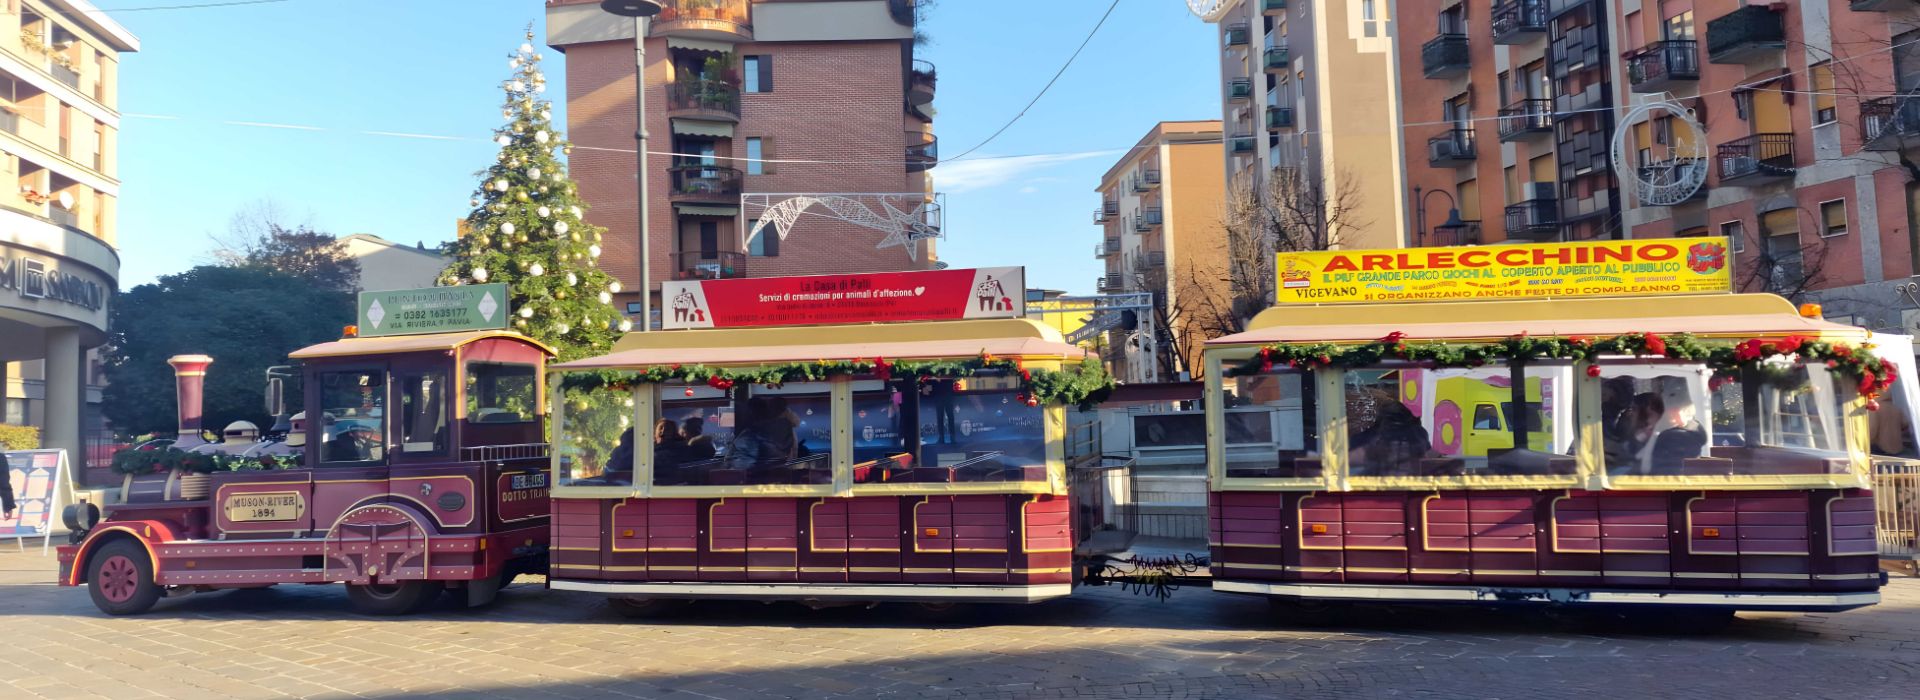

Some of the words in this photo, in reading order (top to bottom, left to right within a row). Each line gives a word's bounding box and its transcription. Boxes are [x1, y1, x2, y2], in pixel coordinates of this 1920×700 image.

[1322, 244, 1680, 272] ARLECCHINO
[1323, 273, 1333, 283] IL
[1357, 271, 1401, 282] GRANDE
[1403, 270, 1440, 281] PARCO
[1442, 268, 1480, 279] GIOCHI
[1482, 268, 1496, 279] AL
[1502, 266, 1553, 278] COPERTO
[1557, 264, 1600, 276] APERTO
[1604, 263, 1620, 275] AL
[1622, 262, 1681, 274] PUBBLICO
[800, 280, 811, 292] La
[814, 280, 837, 291] Casa
[839, 279, 848, 290] di
[759, 292, 782, 302] Servizi
[784, 292, 791, 301] di
[846, 289, 872, 300] animali
[1296, 286, 1357, 299] VIGEVANO
[1364, 293, 1373, 301] SI
[1378, 291, 1472, 300] ORGANIZZANO
[1476, 289, 1521, 297] ANCHE
[1525, 288, 1561, 296] FESTE
[1583, 284, 1681, 294] COMPLEANNO
[403, 309, 426, 320] 0382
[430, 307, 468, 319] 1635177
[233, 496, 295, 508] MUSON-RIVER
[502, 490, 527, 502] DOTTO
[252, 508, 275, 518] 1894
